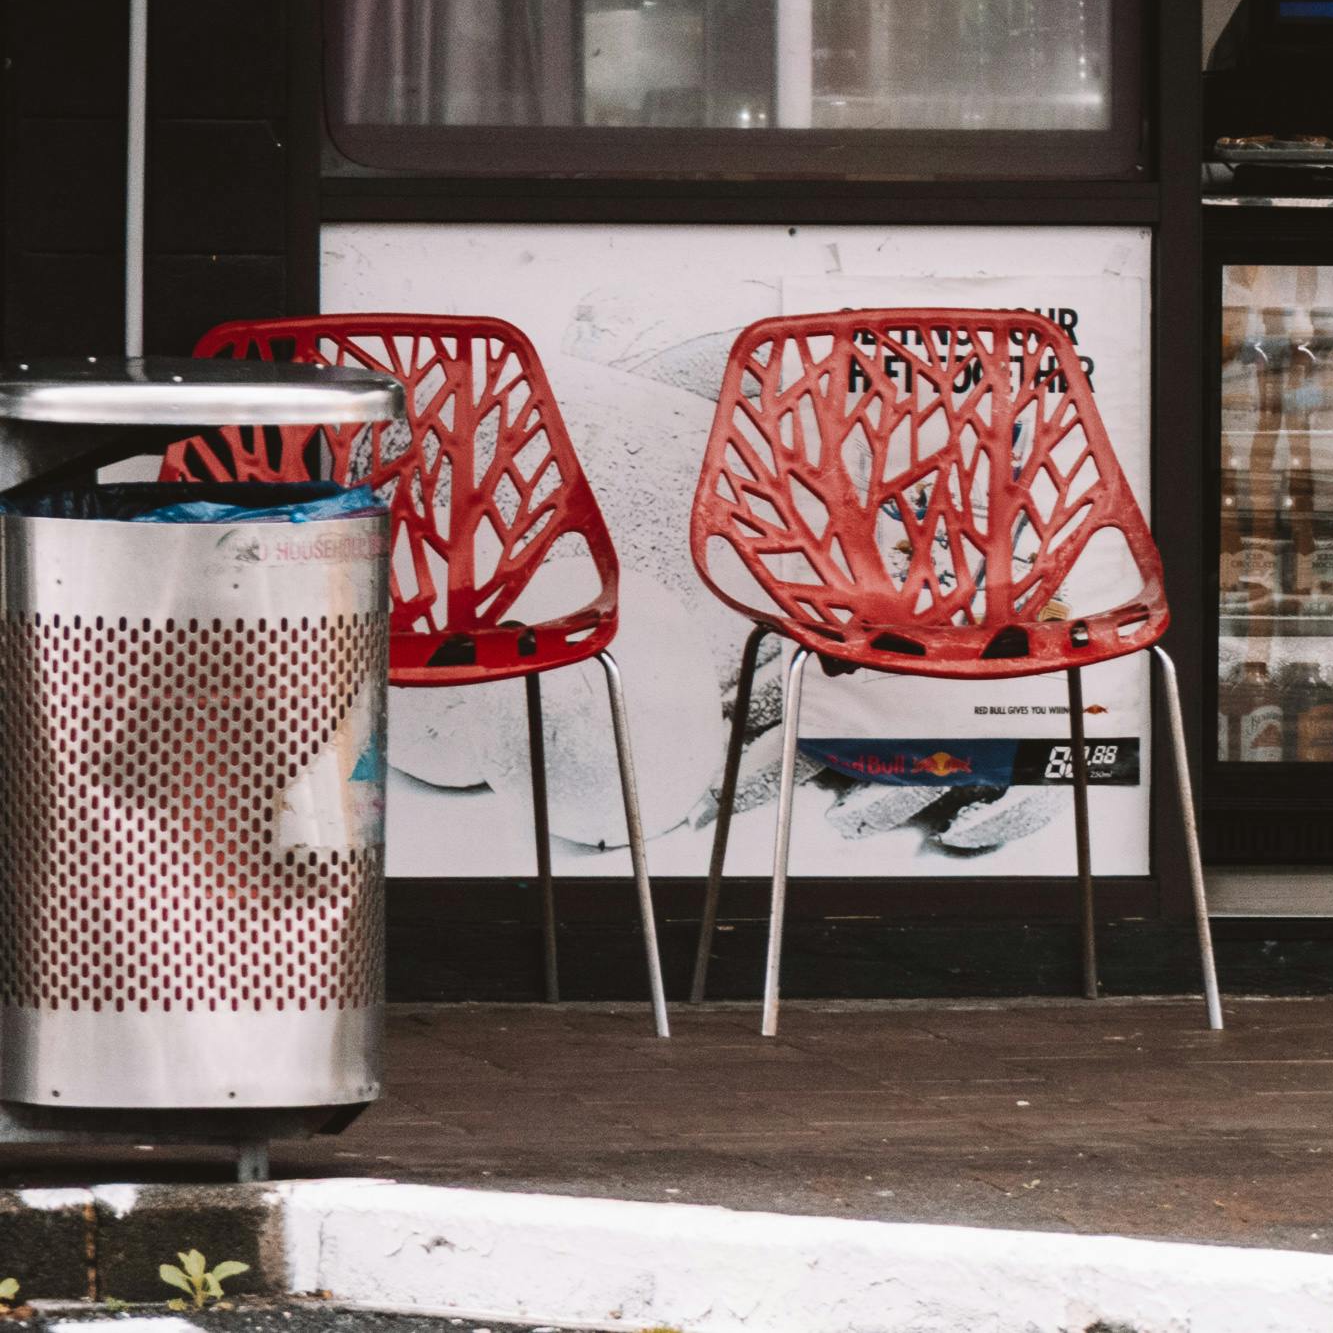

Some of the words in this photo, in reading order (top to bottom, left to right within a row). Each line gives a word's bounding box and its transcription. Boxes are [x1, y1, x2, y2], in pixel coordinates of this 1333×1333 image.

[974, 706, 988, 715] RED
[1008, 706, 1029, 715] GIVES
[1031, 706, 1047, 715] YOU
